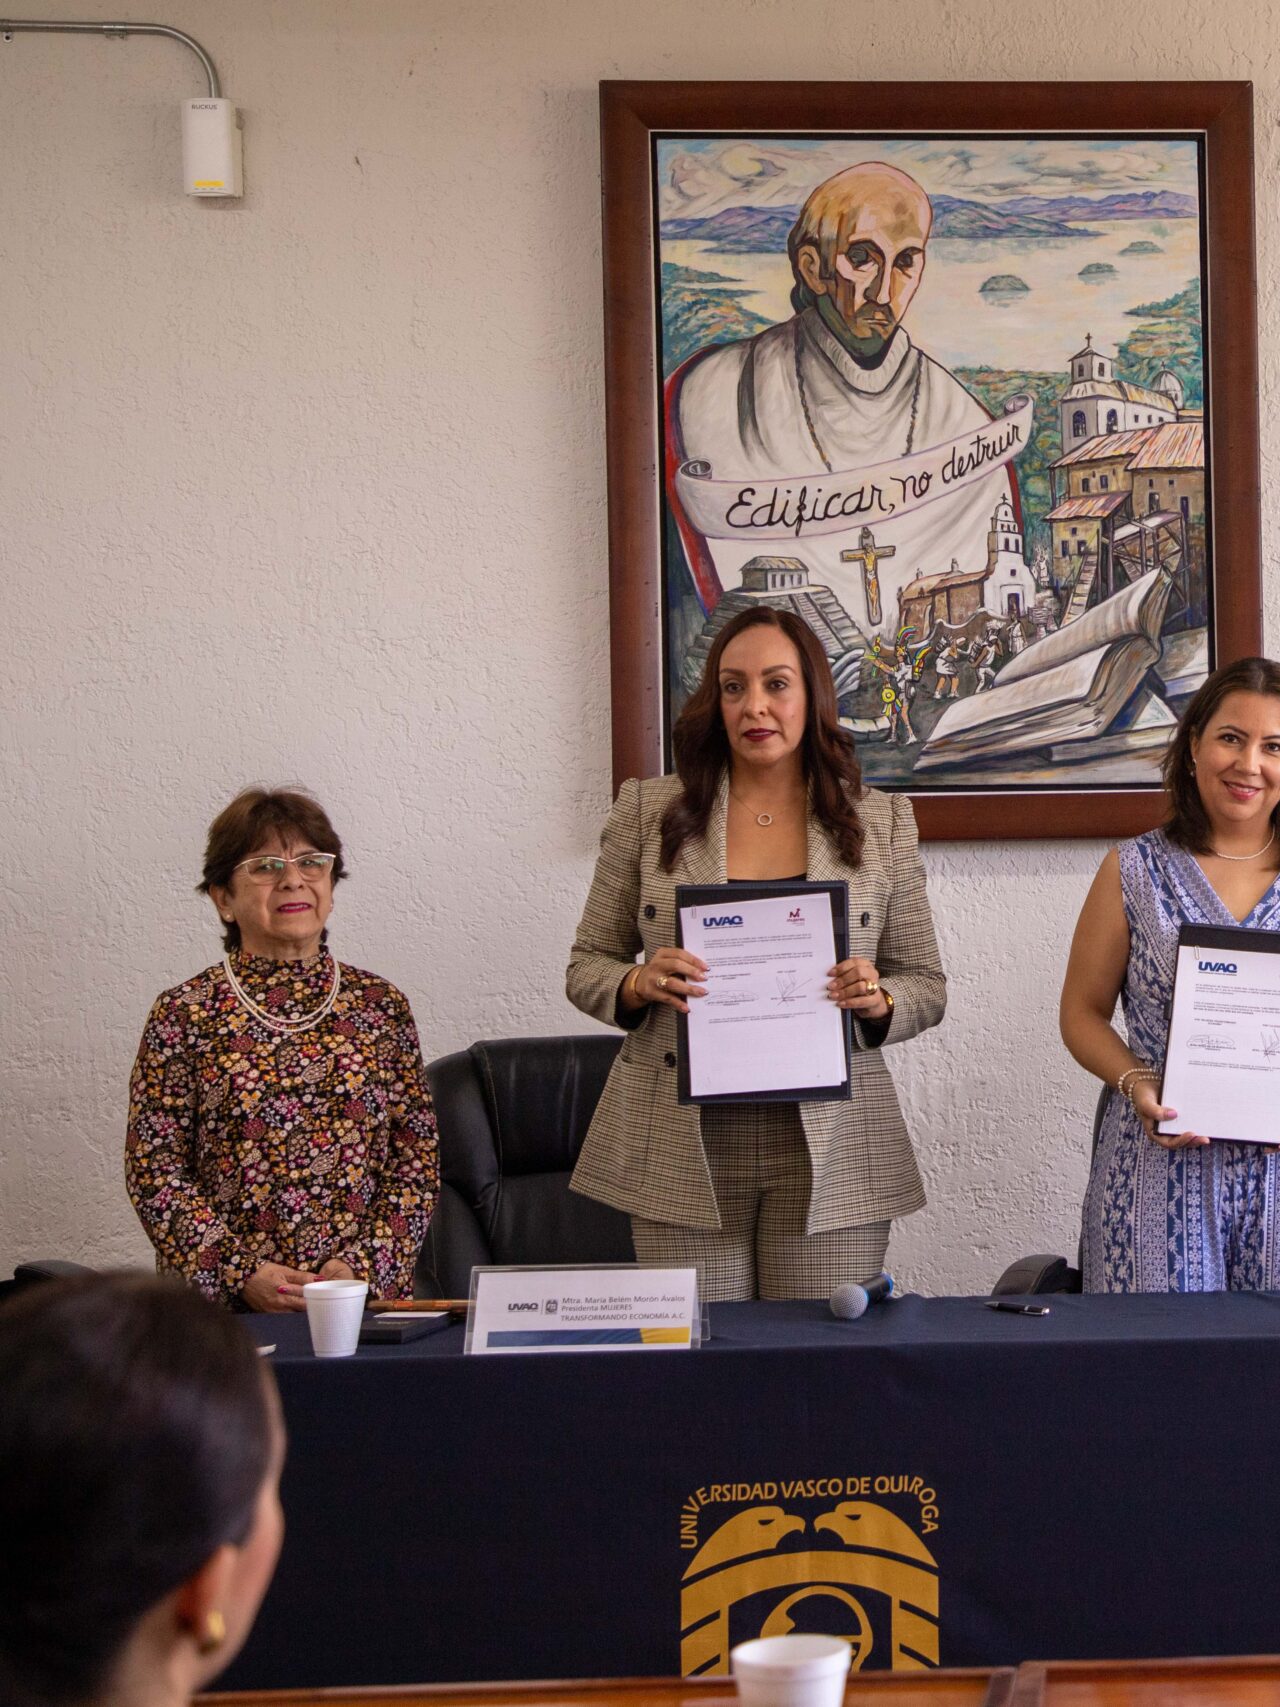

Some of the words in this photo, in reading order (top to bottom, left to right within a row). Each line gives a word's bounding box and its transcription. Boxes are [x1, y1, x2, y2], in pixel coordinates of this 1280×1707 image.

[725, 484, 896, 537] Edificar,
[889, 473, 933, 502] no
[941, 422, 1024, 484] destruir
[703, 915, 744, 927] UVAQ
[1198, 961, 1238, 973] UVAQ
[508, 1303, 539, 1311] UVAQ
[561, 1313, 627, 1321] TRANSFORMANDO
[629, 1312, 669, 1320] ECONOMÍA
[680, 1481, 778, 1549] UNIVERSIDAD
[780, 1478, 843, 1499] VASCO
[846, 1477, 871, 1495] DE
[874, 1475, 939, 1535] QUIROGA
